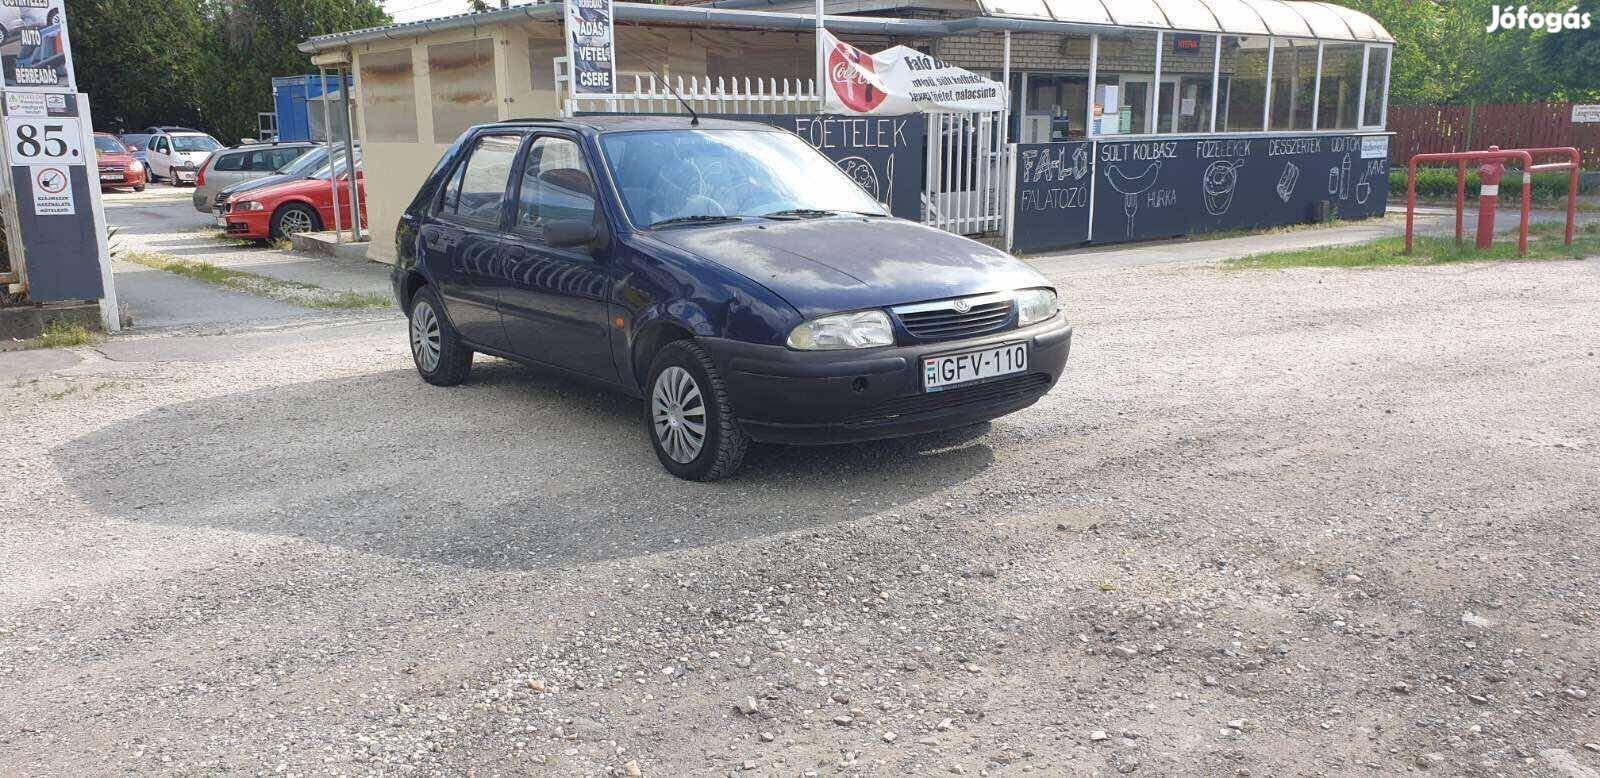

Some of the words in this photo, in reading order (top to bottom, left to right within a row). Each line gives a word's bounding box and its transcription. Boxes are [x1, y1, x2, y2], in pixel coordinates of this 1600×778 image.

[21, 27, 42, 46] AUTÓ
[580, 19, 604, 36] ADÁS
[580, 43, 608, 61] VÉTEL
[16, 66, 58, 84] BÉRBEADÁS
[581, 72, 609, 87] CSERE
[955, 87, 996, 101] palacsinta
[16, 124, 79, 157] 85.
[796, 116, 907, 150] FŐÉTELEK
[942, 346, 1025, 382] GFV-110
[927, 373, 936, 384] H
